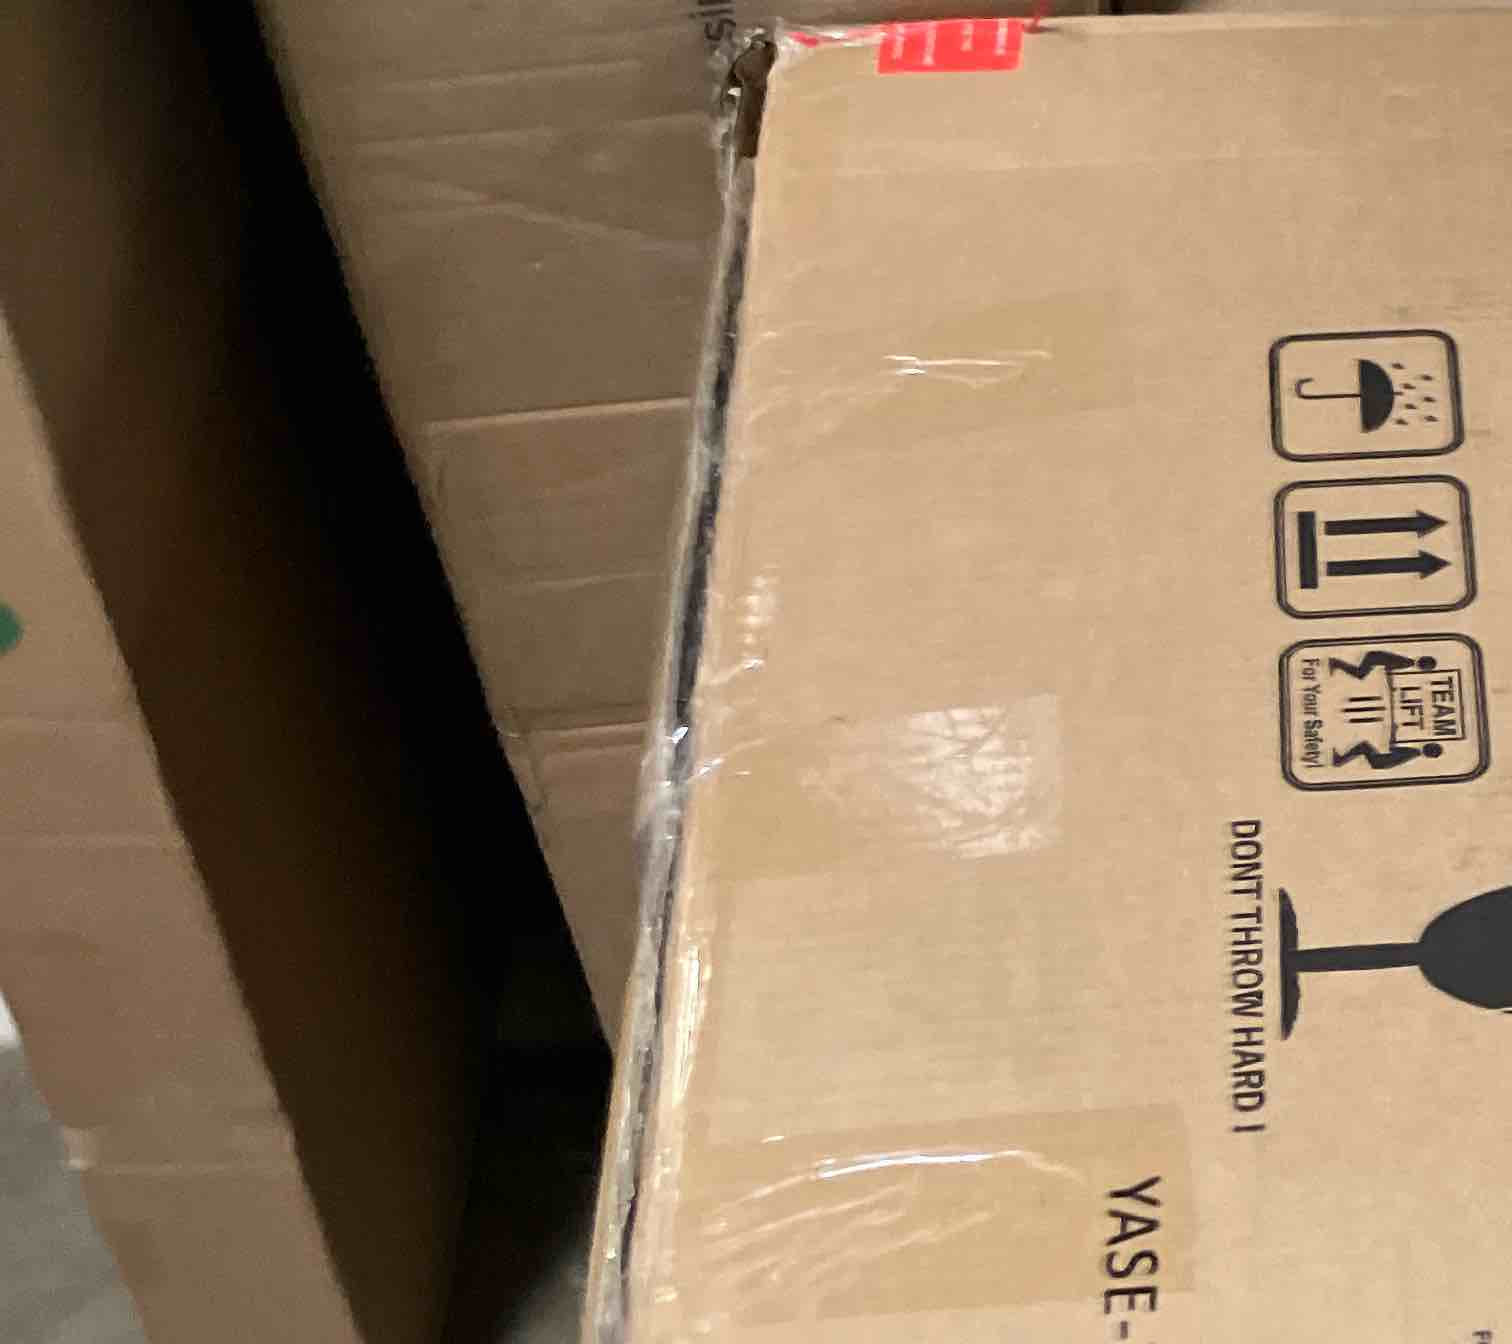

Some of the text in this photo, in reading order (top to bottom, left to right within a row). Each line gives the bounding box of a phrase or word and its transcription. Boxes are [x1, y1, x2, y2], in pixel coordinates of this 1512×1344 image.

[1299, 684, 1323, 714] Your
[1300, 658, 1320, 679] For
[1399, 684, 1425, 729] LIFT
[1430, 674, 1459, 738] TEAM
[1231, 819, 1262, 898] DONT
[1231, 905, 1263, 1018] THROW
[1231, 1026, 1266, 1112] HARD
